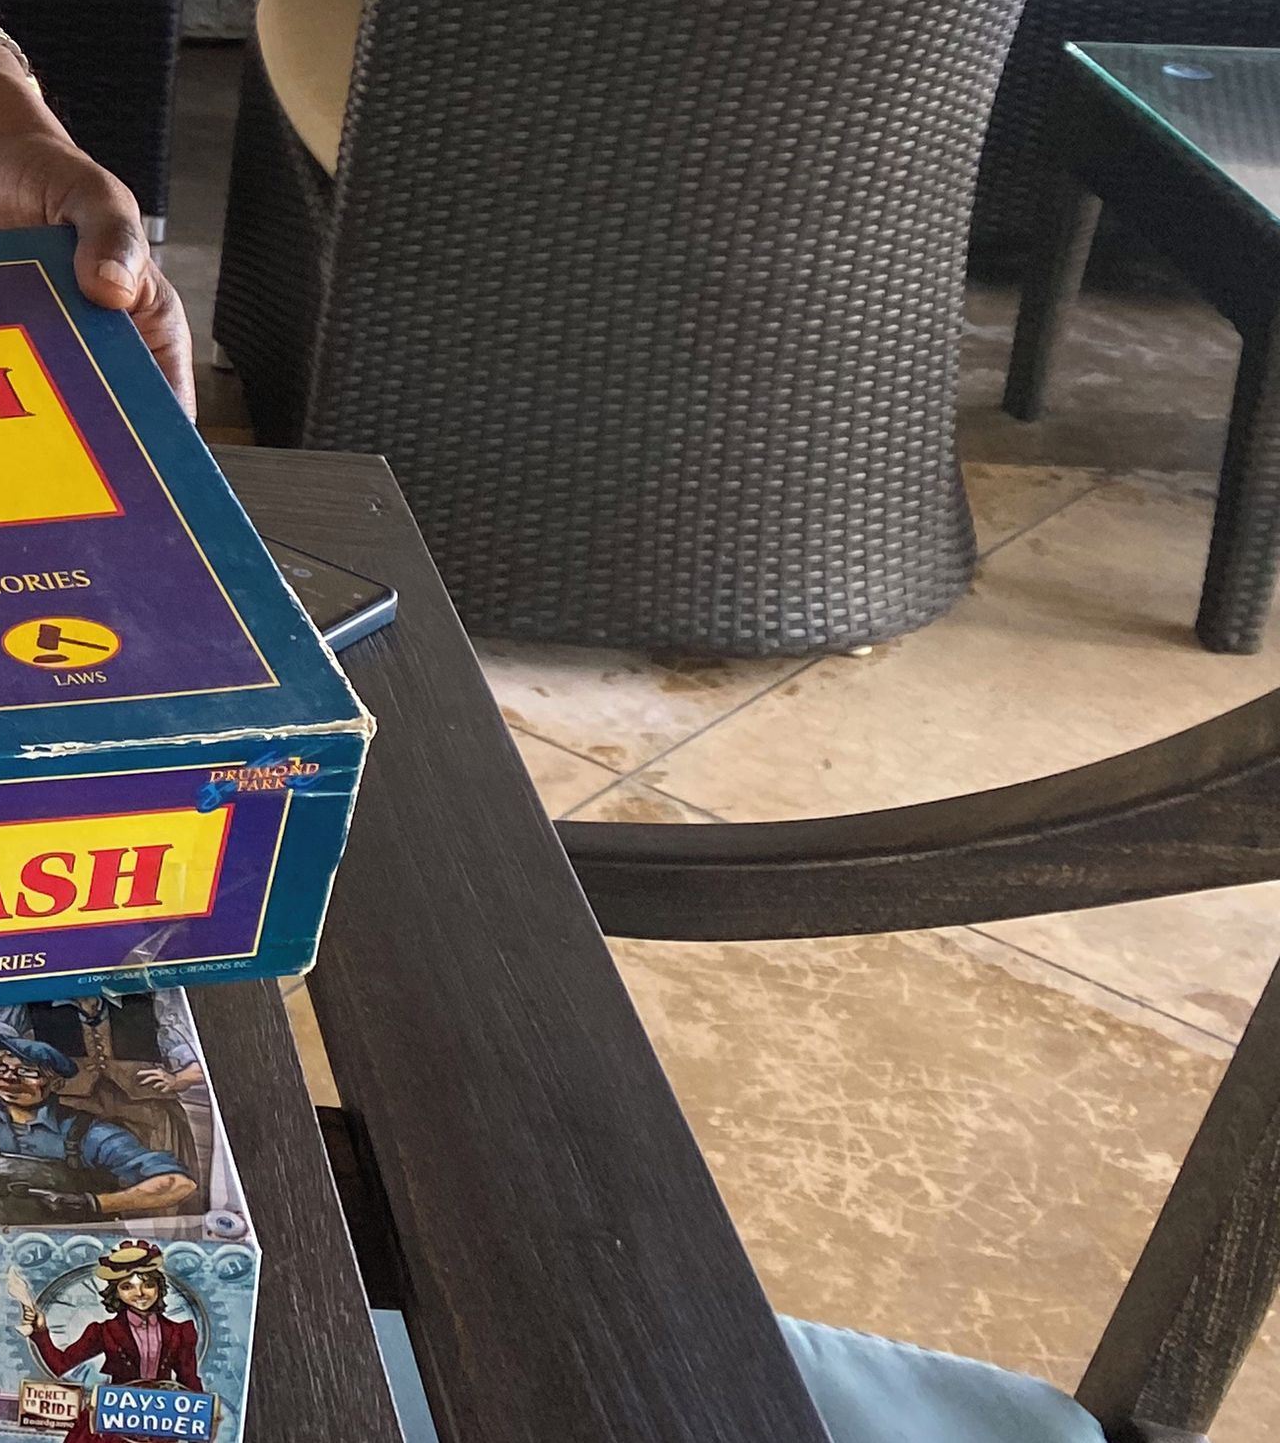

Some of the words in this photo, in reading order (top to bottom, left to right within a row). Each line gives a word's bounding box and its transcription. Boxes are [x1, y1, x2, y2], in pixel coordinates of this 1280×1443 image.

[53, 670, 107, 687] LAWS
[209, 762, 320, 783] DRUMOND
[25, 1387, 68, 1401] TICKET
[103, 1391, 166, 1411] DAYS
[174, 1395, 208, 1414] OF
[39, 1400, 78, 1418] RIDE
